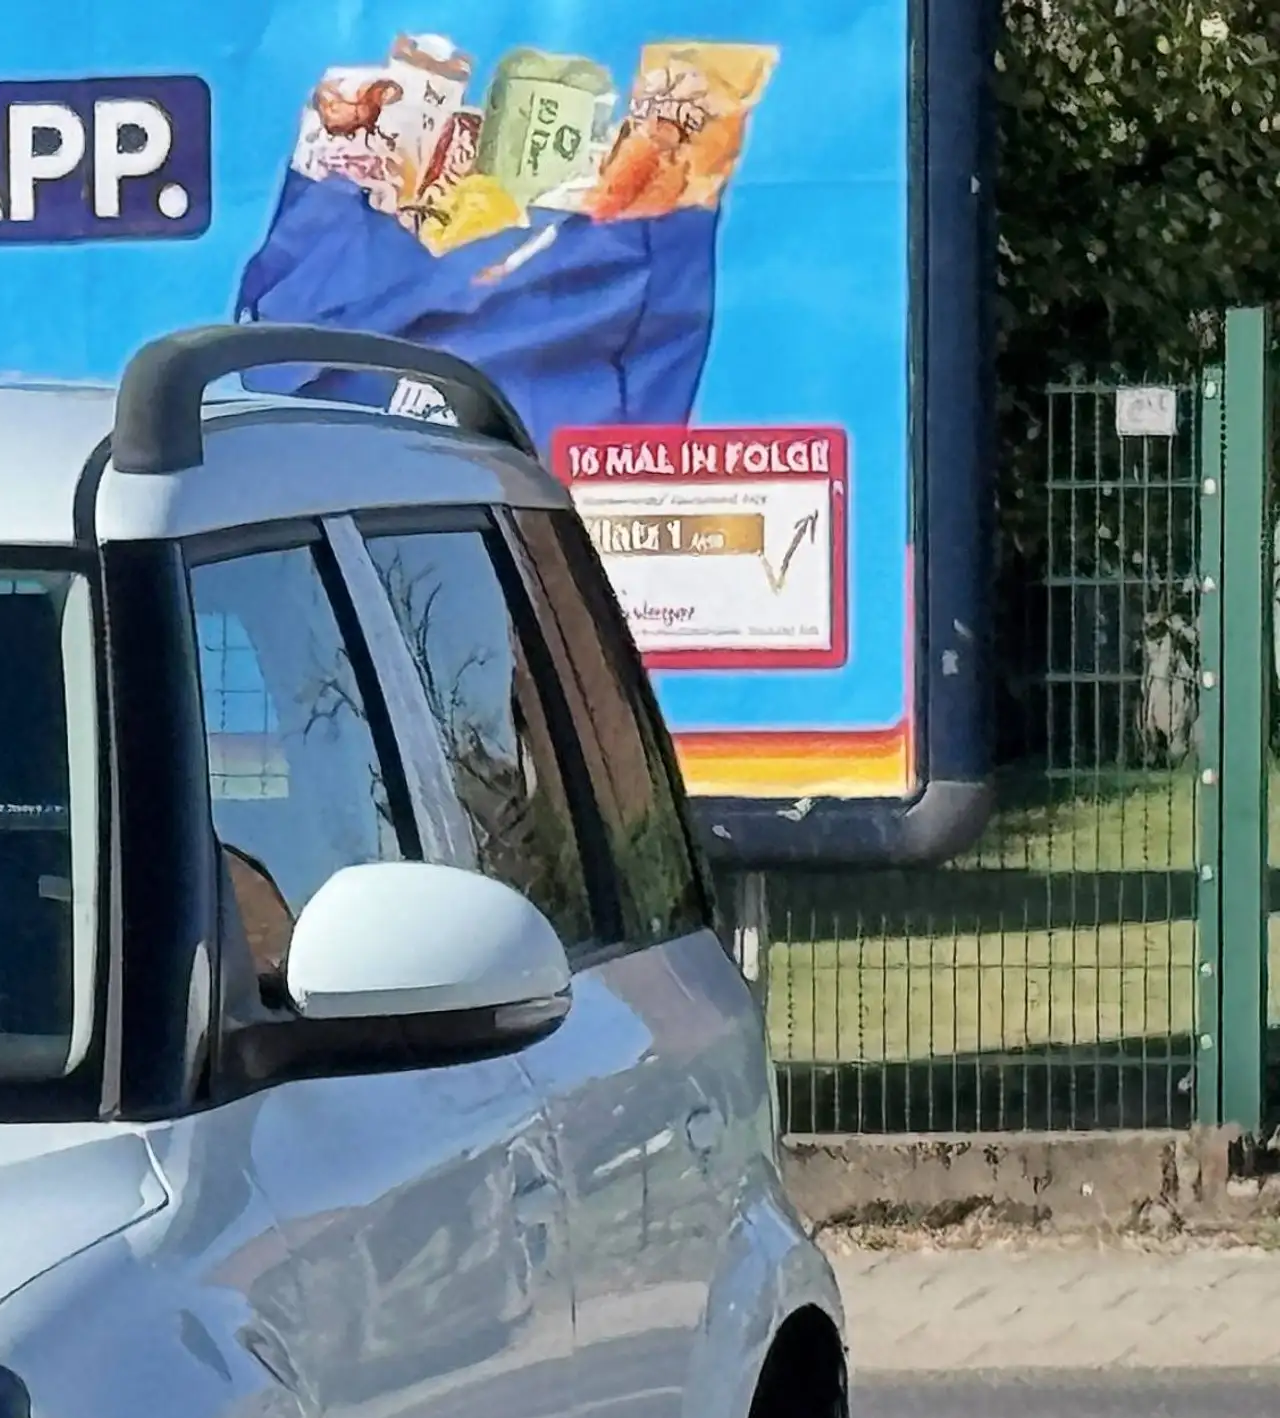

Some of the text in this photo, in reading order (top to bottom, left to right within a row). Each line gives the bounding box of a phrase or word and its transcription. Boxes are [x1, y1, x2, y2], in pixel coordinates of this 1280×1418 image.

[605, 441, 675, 476] MAL
[682, 440, 718, 476] IN
[725, 438, 830, 475] FOLGE
